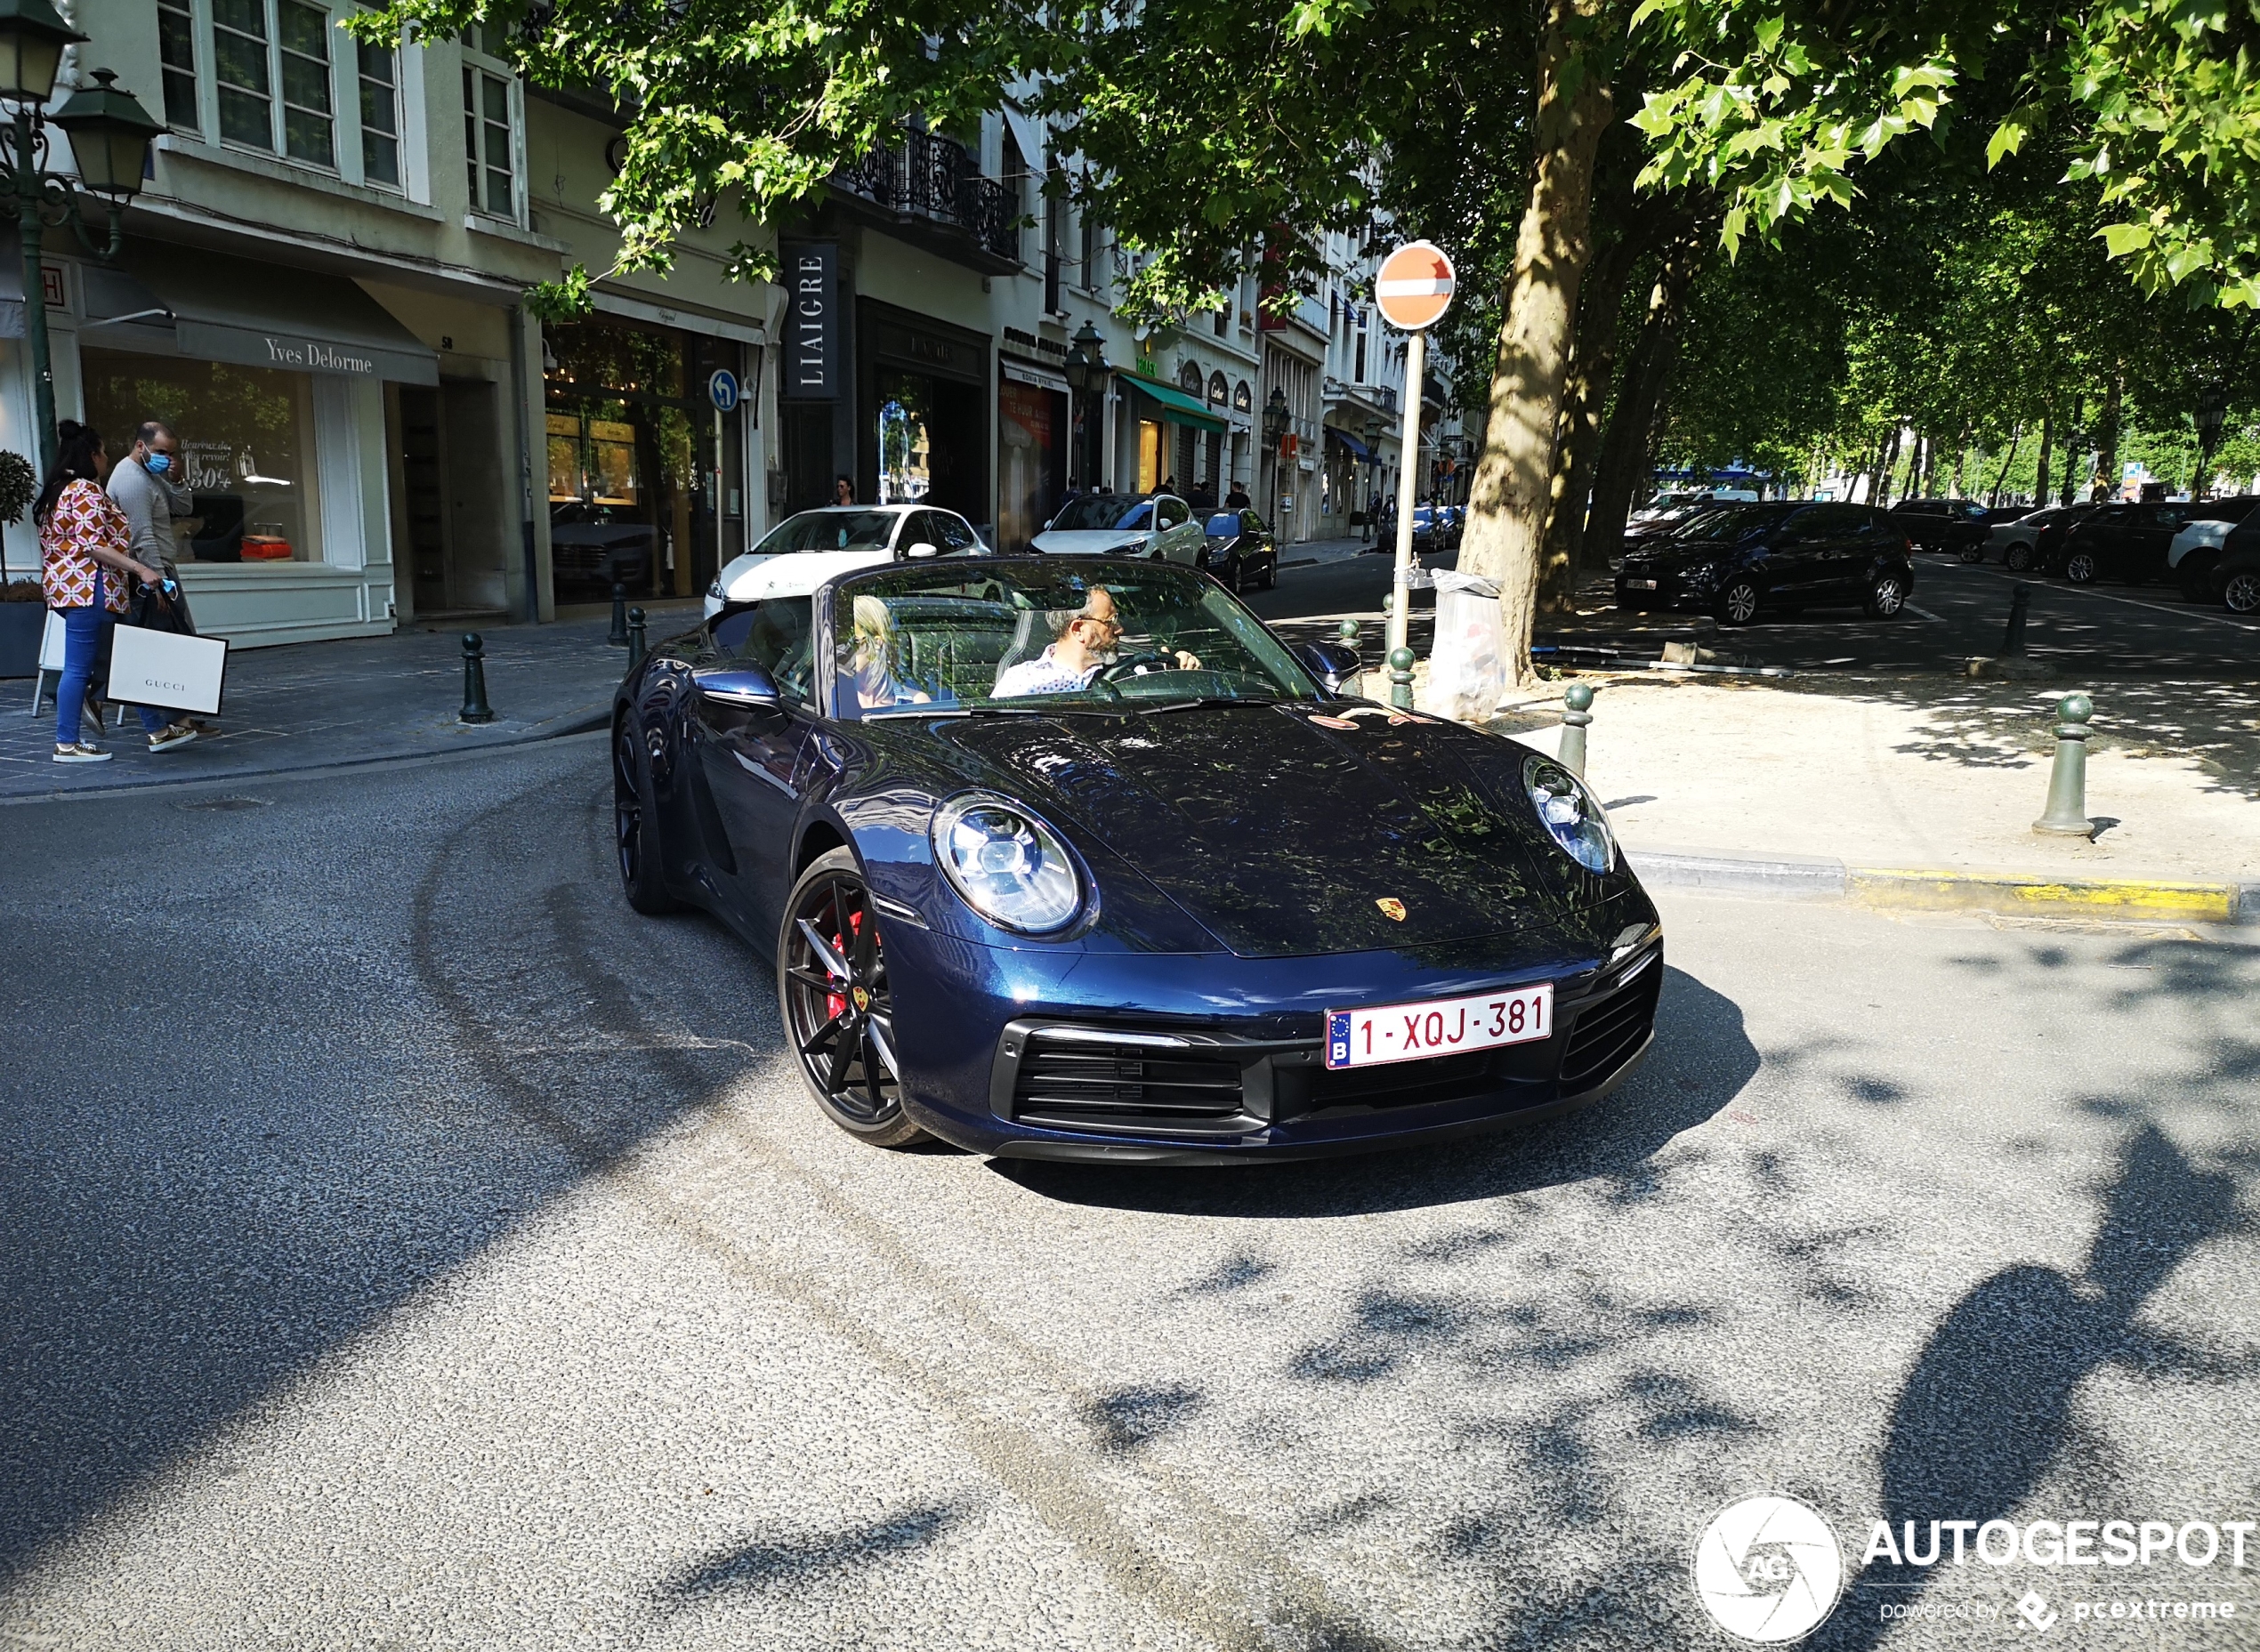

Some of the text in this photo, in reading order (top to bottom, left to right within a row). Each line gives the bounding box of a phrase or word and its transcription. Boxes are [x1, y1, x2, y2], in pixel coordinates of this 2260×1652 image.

[799, 256, 824, 386] LIAIGRE
[441, 336, 453, 350] 58
[265, 337, 372, 374] Yves Delorme
[1211, 382, 1224, 400] Cartier
[1236, 390, 1247, 407] Cartier
[202, 452, 230, 462] revoir!
[145, 679, 185, 692] GUCCI
[1361, 995, 1542, 1055] 1-XQJ-381
[1333, 1042, 1347, 1060] B
